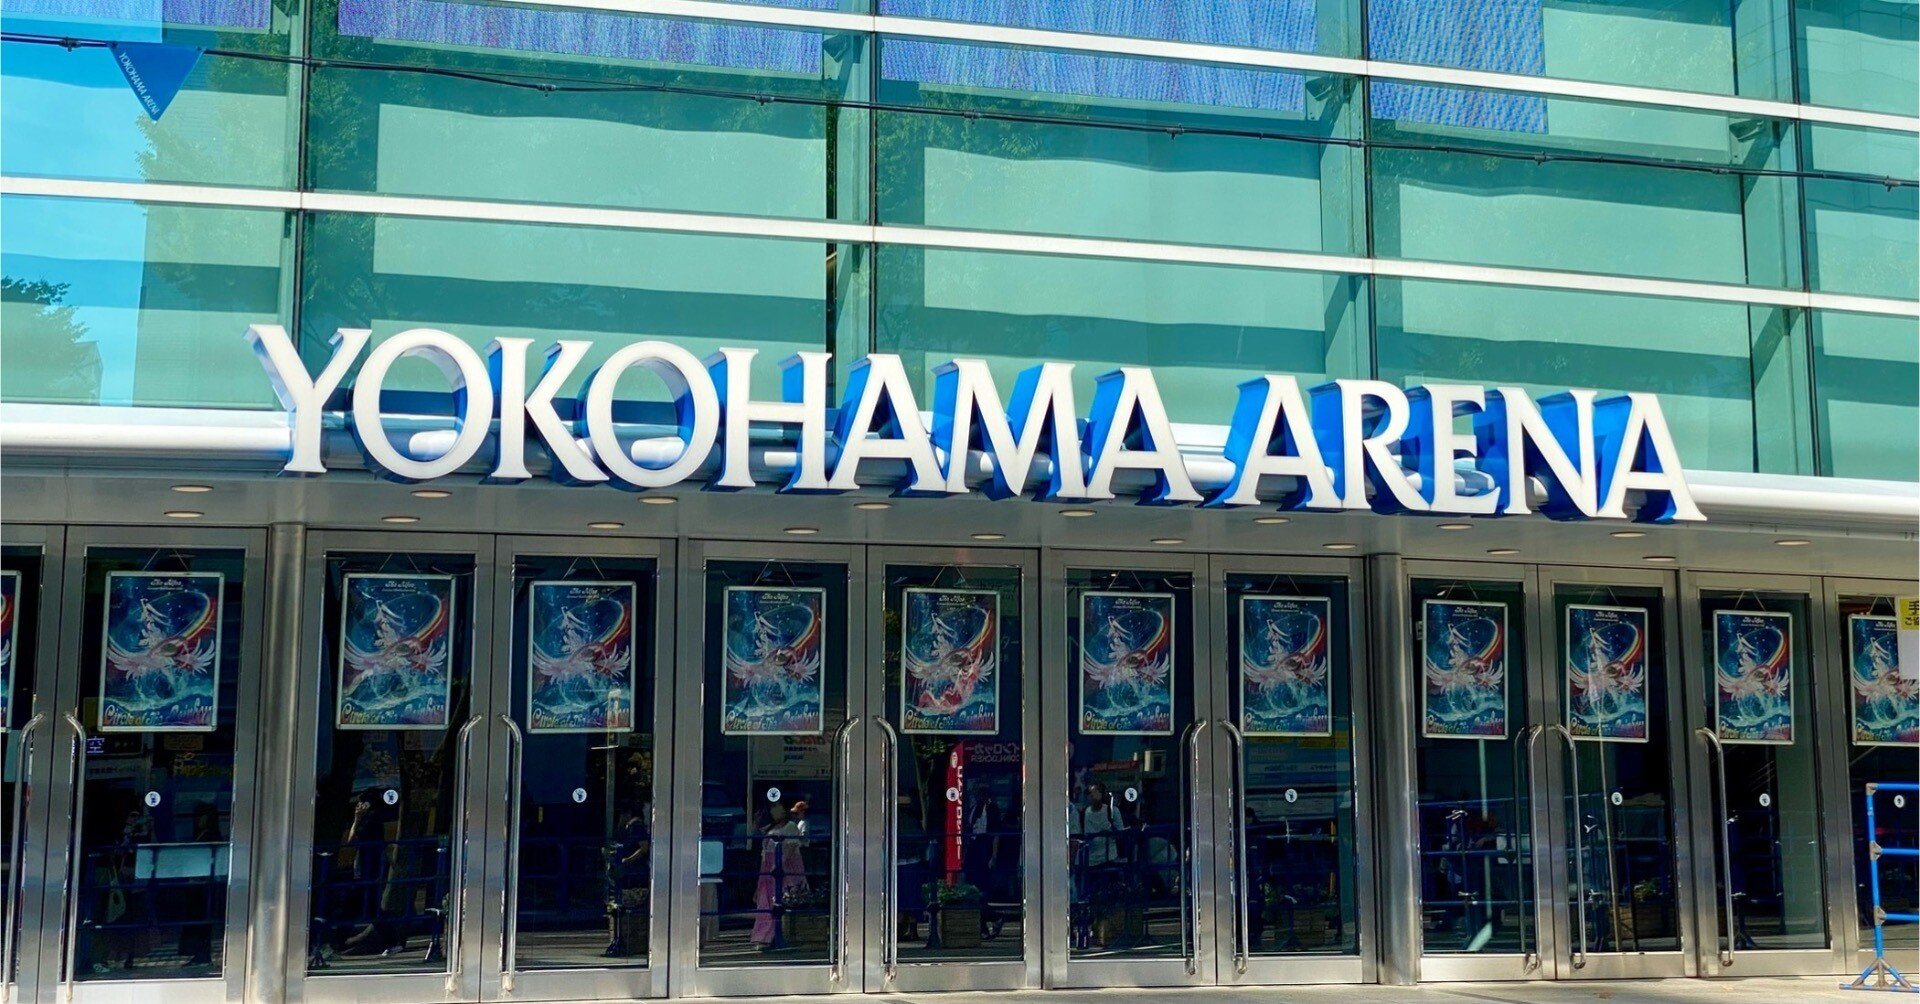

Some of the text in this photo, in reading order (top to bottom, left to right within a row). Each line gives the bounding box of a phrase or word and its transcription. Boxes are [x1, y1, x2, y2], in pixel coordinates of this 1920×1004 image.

[119, 52, 147, 95] YOKOHAMA
[246, 324, 1708, 521] YOKOHAMA ARENA
